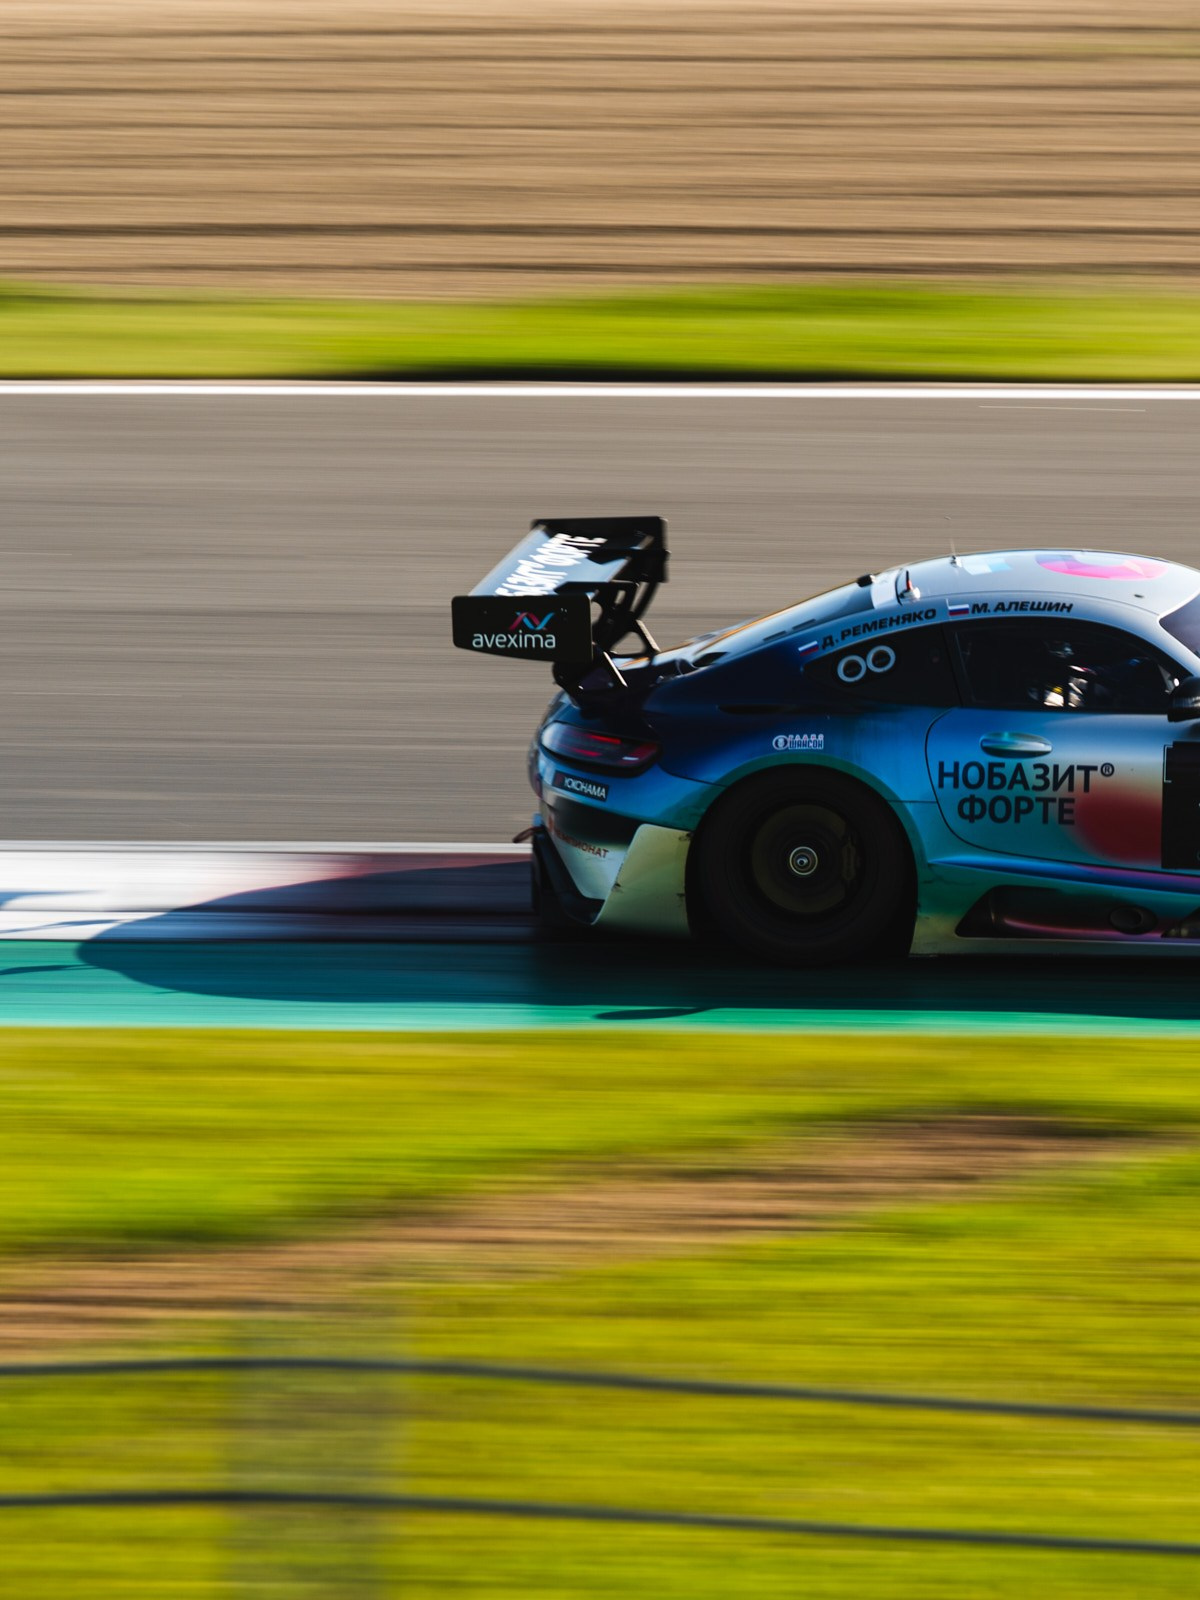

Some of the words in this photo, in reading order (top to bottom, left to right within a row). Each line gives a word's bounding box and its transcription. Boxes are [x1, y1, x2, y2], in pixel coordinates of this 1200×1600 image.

[971, 602, 991, 614] М.
[993, 600, 1074, 613] АЛЕШИН
[472, 629, 556, 649] avexima
[821, 634, 840, 650] Д.
[841, 608, 937, 642] РЕМЕНЯКО
[564, 776, 606, 799] YOKOHAMA
[957, 794, 1076, 825] ФОРТЕ
